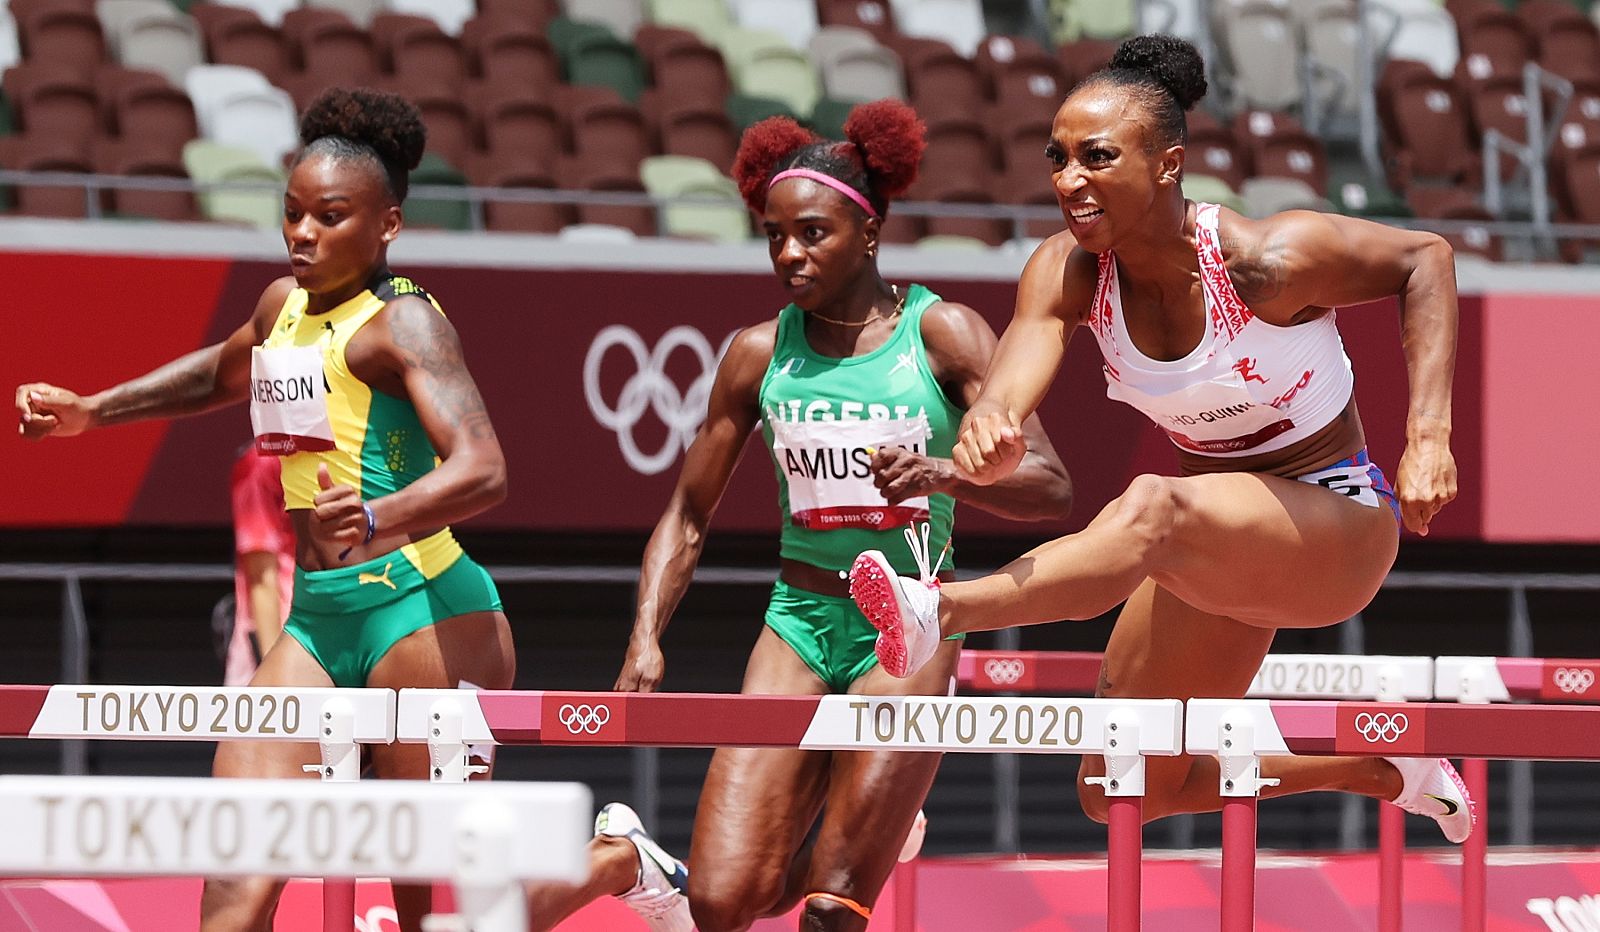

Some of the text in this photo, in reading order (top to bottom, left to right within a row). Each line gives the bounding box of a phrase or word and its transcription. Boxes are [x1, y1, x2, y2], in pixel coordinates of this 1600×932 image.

[785, 443, 919, 480] AMUS
[1295, 663, 1364, 692] 2020
[76, 692, 301, 734] TOKYO 2020
[849, 701, 1083, 746] TOKYO 2020
[36, 795, 421, 866] TOKYO 2020
